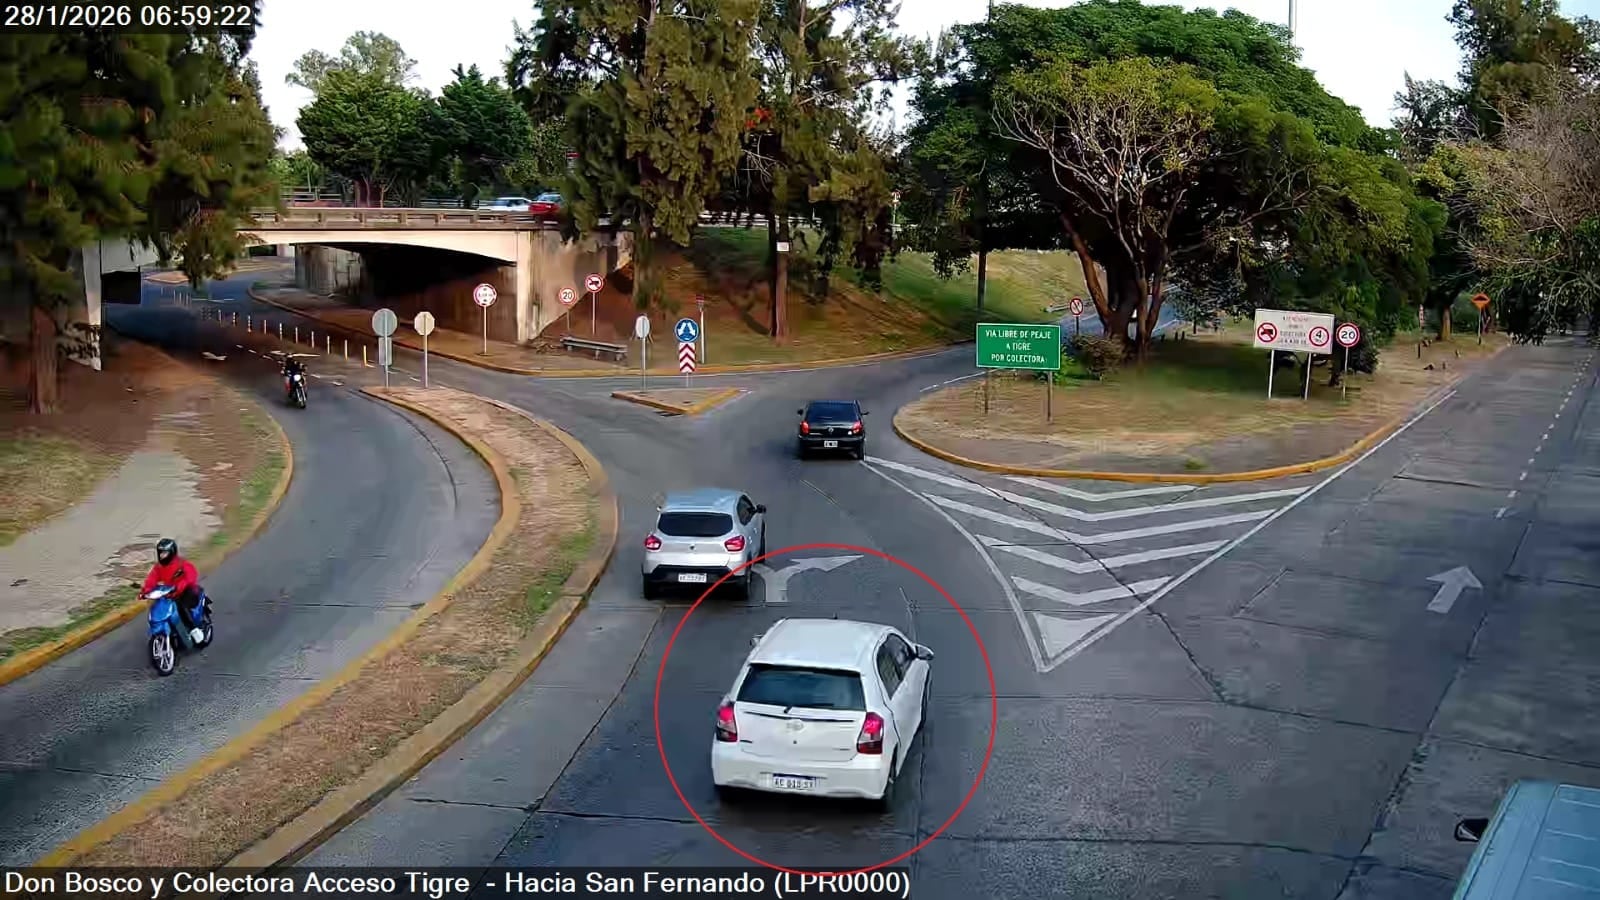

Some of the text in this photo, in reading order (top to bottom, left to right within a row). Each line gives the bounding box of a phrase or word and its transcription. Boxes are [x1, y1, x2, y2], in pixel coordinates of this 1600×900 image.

[563, 291, 573, 300] 20
[985, 329, 1052, 339] VIA LIBRE DE PEAJE
[1341, 330, 1356, 340] 20
[1012, 342, 1032, 351] TIGRE
[991, 353, 1045, 363] POR COLECTORA
